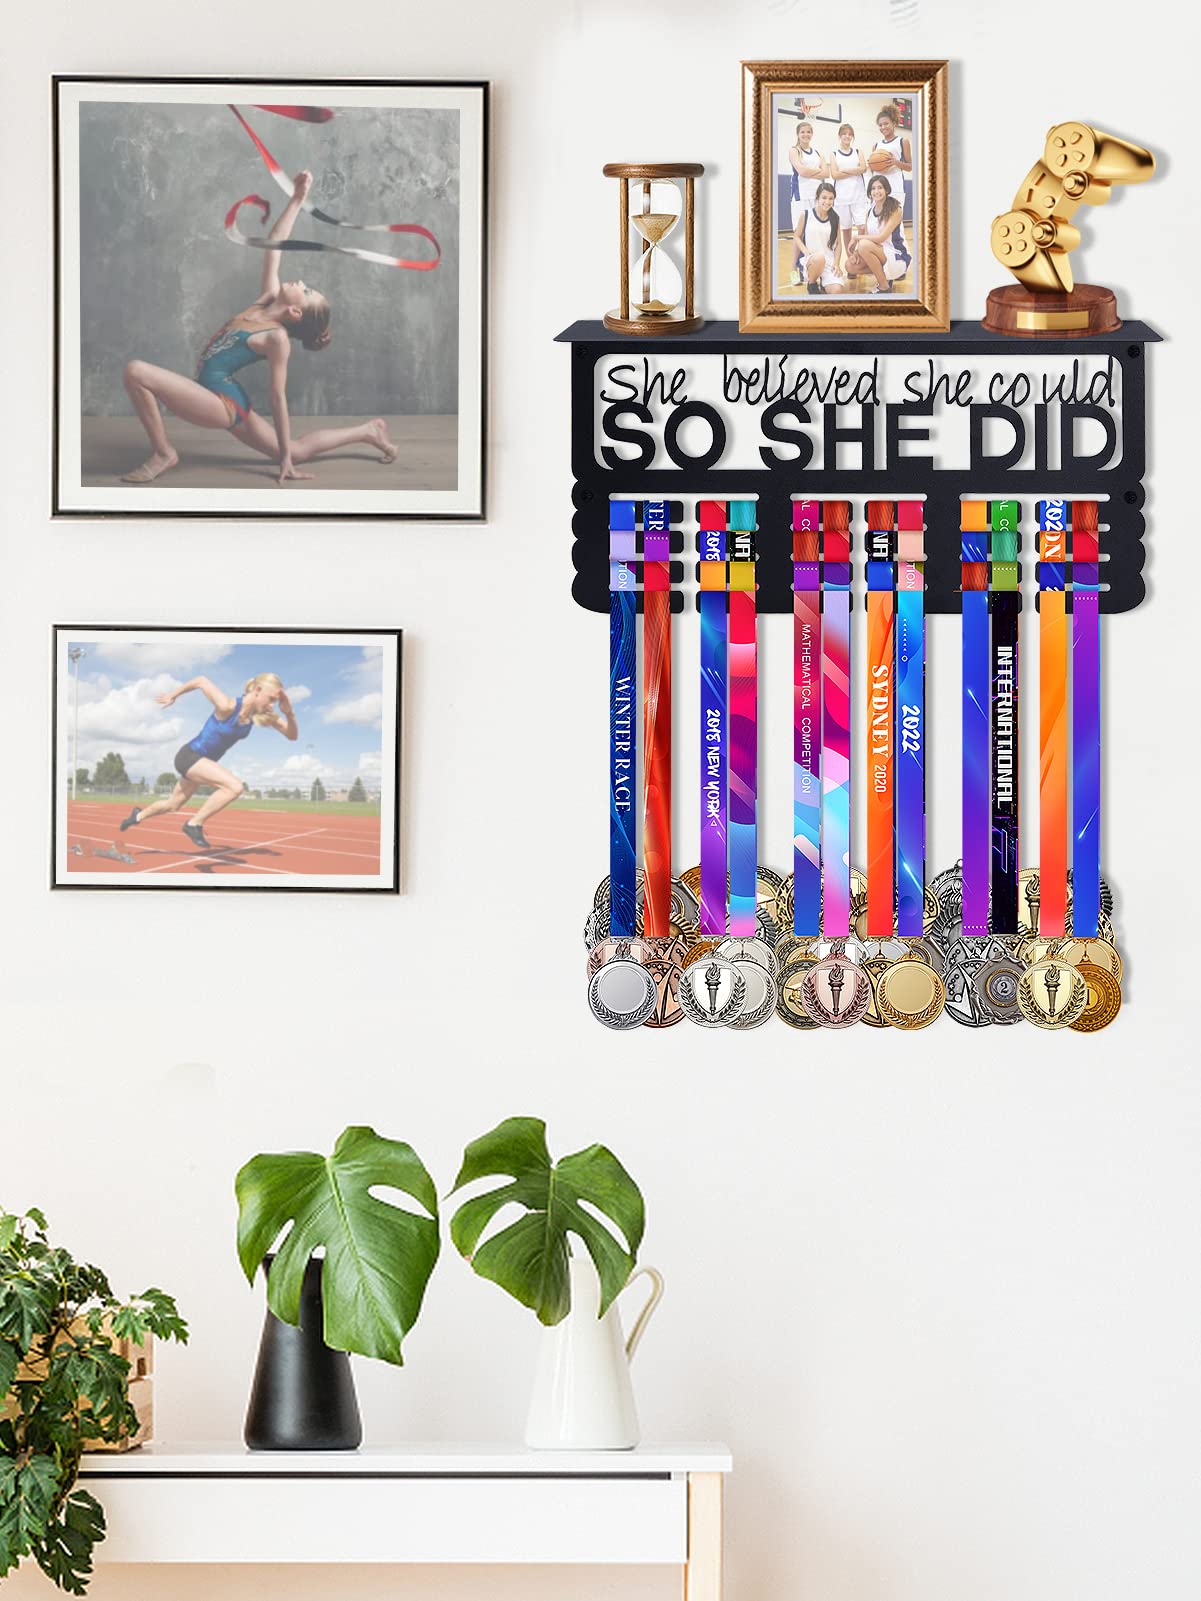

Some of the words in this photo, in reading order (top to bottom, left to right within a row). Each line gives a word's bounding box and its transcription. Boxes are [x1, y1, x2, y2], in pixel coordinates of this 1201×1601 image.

[723, 354, 880, 407] believed
[903, 358, 974, 407] she
[600, 400, 726, 471] SO
[758, 400, 934, 471] SHE
[969, 403, 1117, 471] DID
[801, 623, 812, 710] MATHEMATICAL
[615, 676, 631, 752] WINTER
[705, 708, 721, 743] 2018
[872, 664, 889, 758] SYDNEY
[901, 703, 921, 754] 2022
[997, 646, 1013, 809] INTERNATIONAL
[615, 758, 631, 812] RACE
[706, 745, 721, 778] NEW
[801, 717, 812, 794] COMPETITION
[874, 764, 887, 793] 2020
